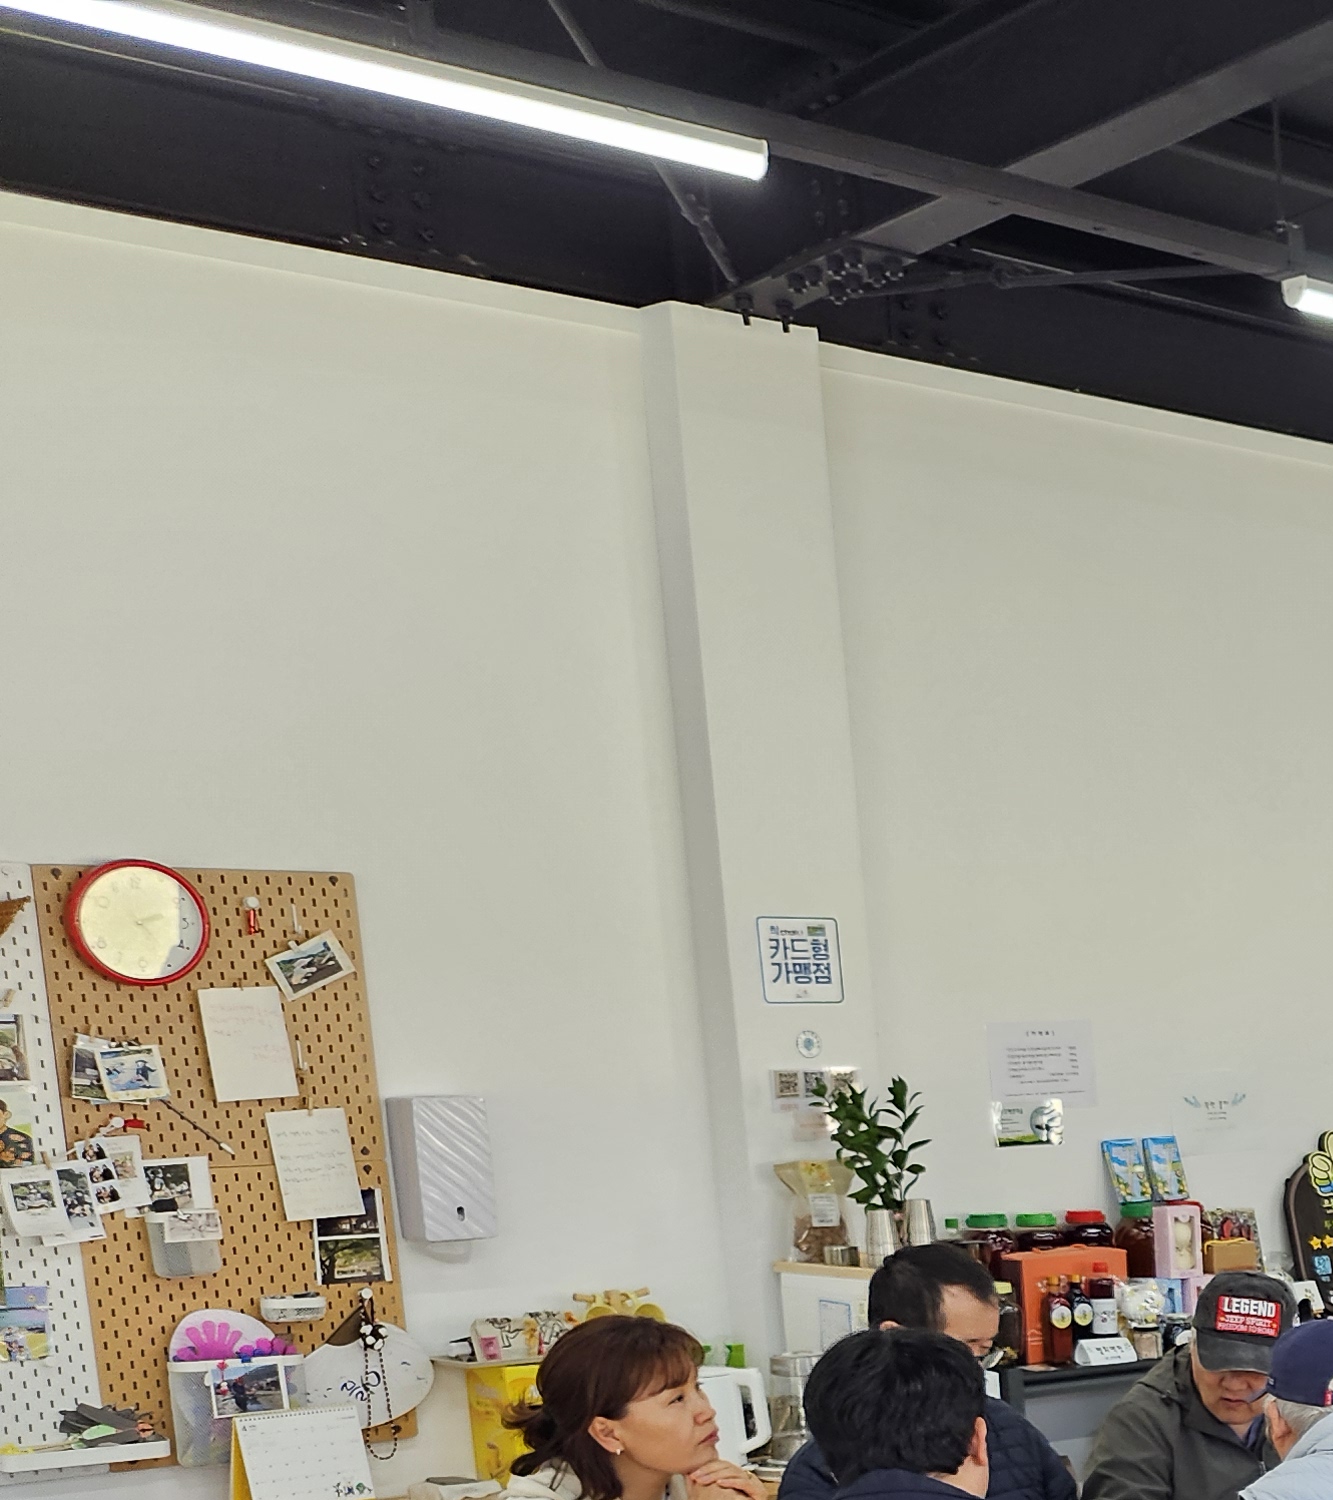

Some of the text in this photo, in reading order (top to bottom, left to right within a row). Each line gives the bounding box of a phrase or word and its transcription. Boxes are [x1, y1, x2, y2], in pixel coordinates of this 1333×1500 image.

[768, 938, 830, 960] 카드형
[771, 962, 832, 984] 가맹점
[1223, 1297, 1276, 1318] LEGEND
